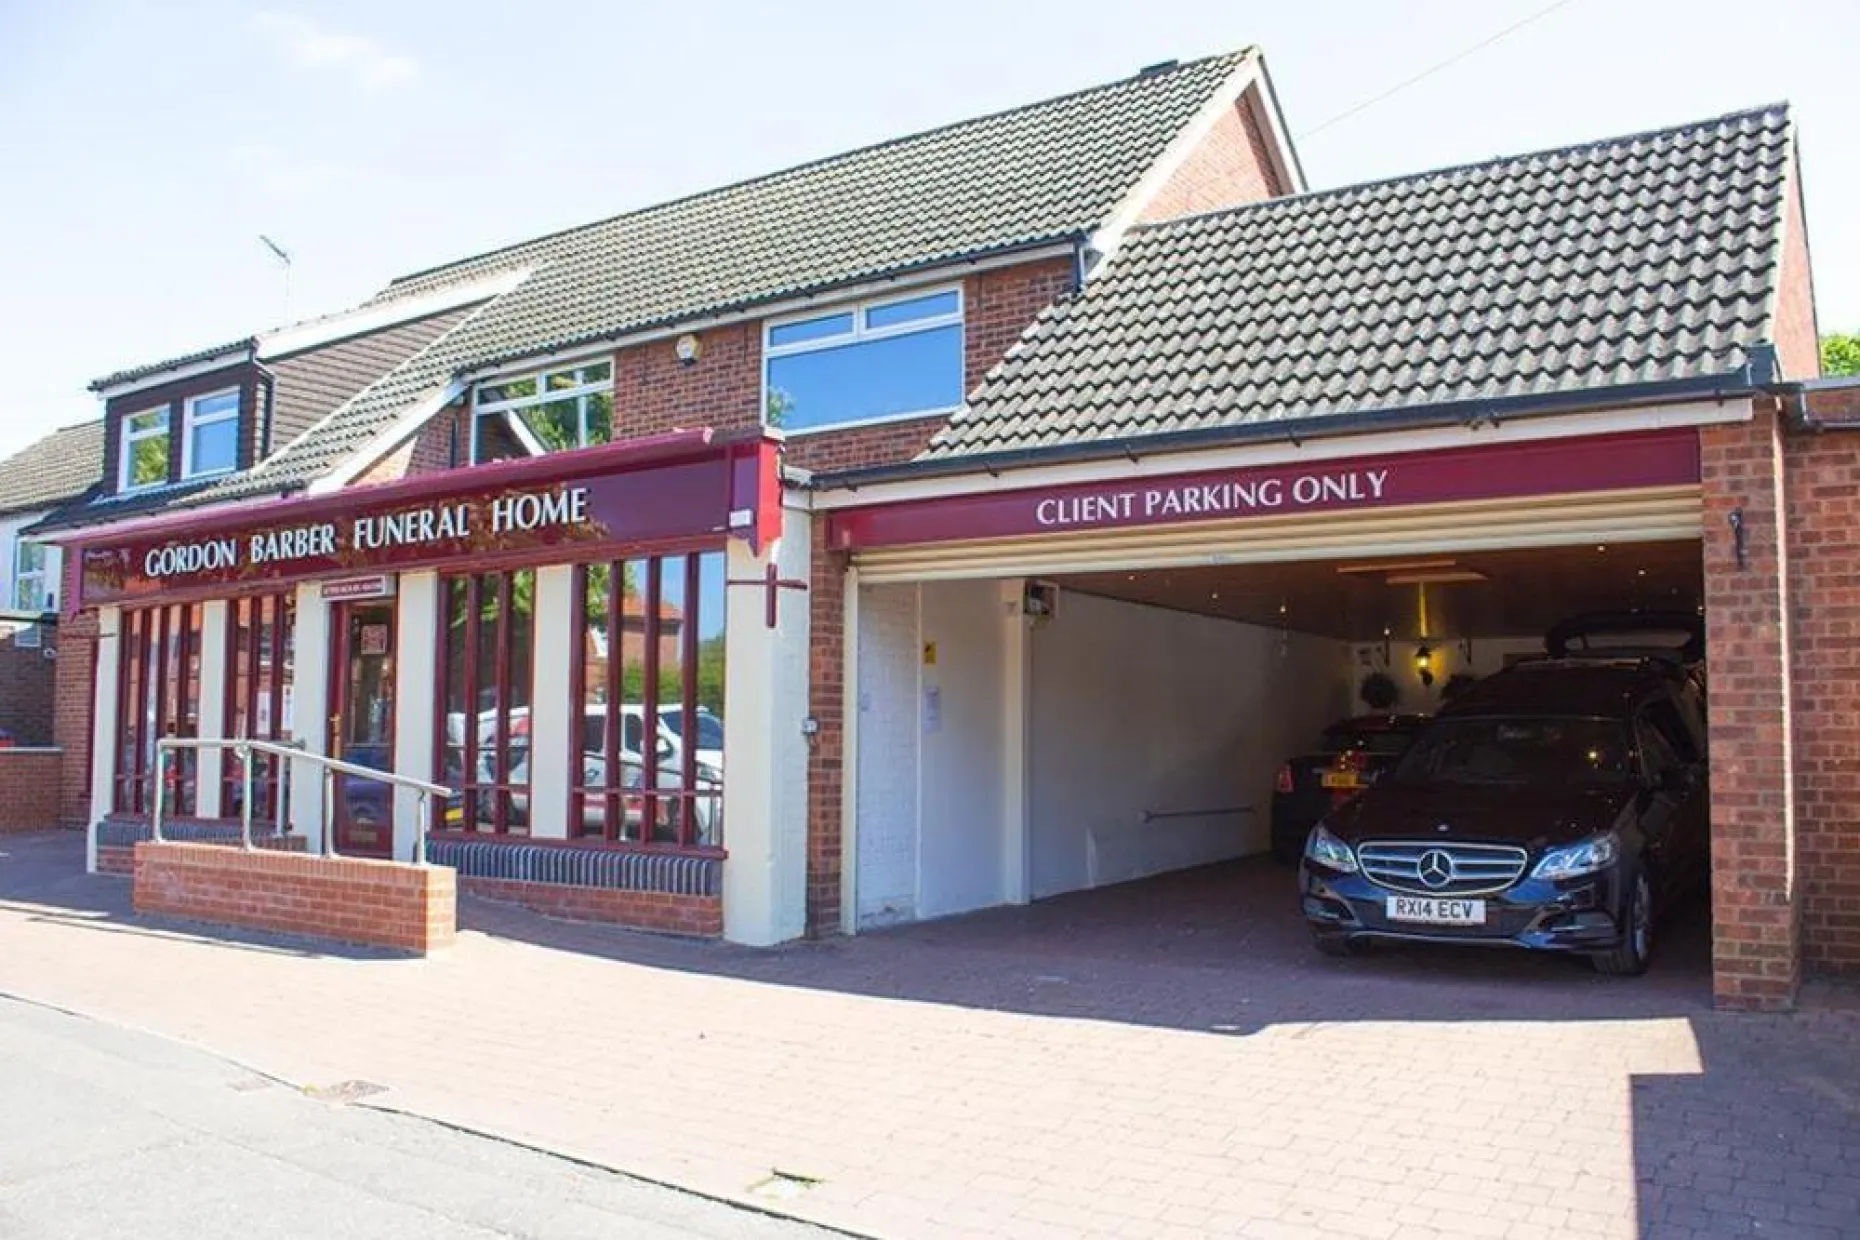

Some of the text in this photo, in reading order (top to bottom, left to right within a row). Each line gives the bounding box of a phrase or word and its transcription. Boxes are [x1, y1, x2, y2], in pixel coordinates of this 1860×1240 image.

[1035, 469, 1389, 525] CLIENT PARKING ONLY
[144, 487, 588, 577] GORDON BARBER FUNERAL HOME
[1396, 899, 1474, 919] RX14 ECV
